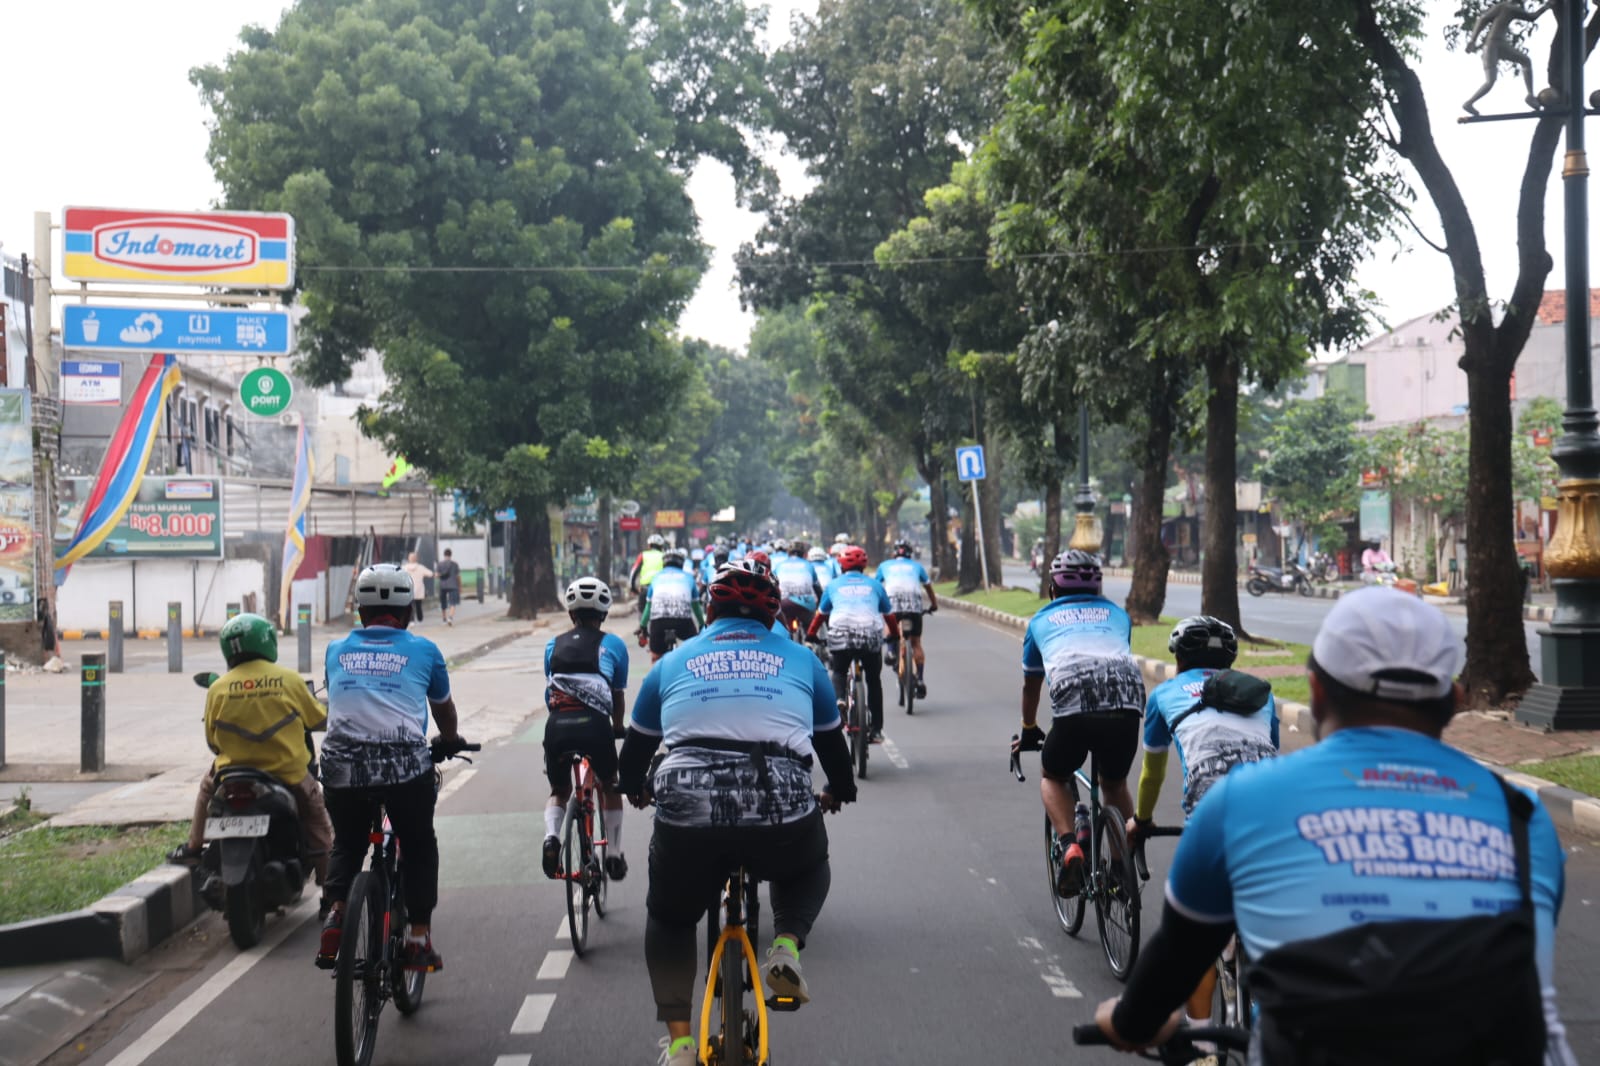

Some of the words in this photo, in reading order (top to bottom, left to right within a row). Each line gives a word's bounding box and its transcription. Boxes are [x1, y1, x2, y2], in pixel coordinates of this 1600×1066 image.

[104, 230, 245, 260] Indomaret
[236, 316, 268, 325] PAKET
[178, 335, 222, 346] payment
[80, 379, 102, 387] ATM
[157, 504, 192, 512] MURAH
[339, 652, 375, 663] GOWES
[375, 652, 409, 666] NAPAK
[686, 650, 737, 671] GOWES
[739, 649, 785, 669] NAPAK
[342, 660, 368, 672] TILAS
[368, 660, 402, 673] BOGOR
[691, 661, 730, 679] TILAS
[732, 659, 778, 677] BOGOR
[739, 671, 767, 680] BUPATI
[229, 675, 283, 692] maxim
[1297, 807, 1421, 840] GOWES
[1317, 833, 1409, 864] TILAS
